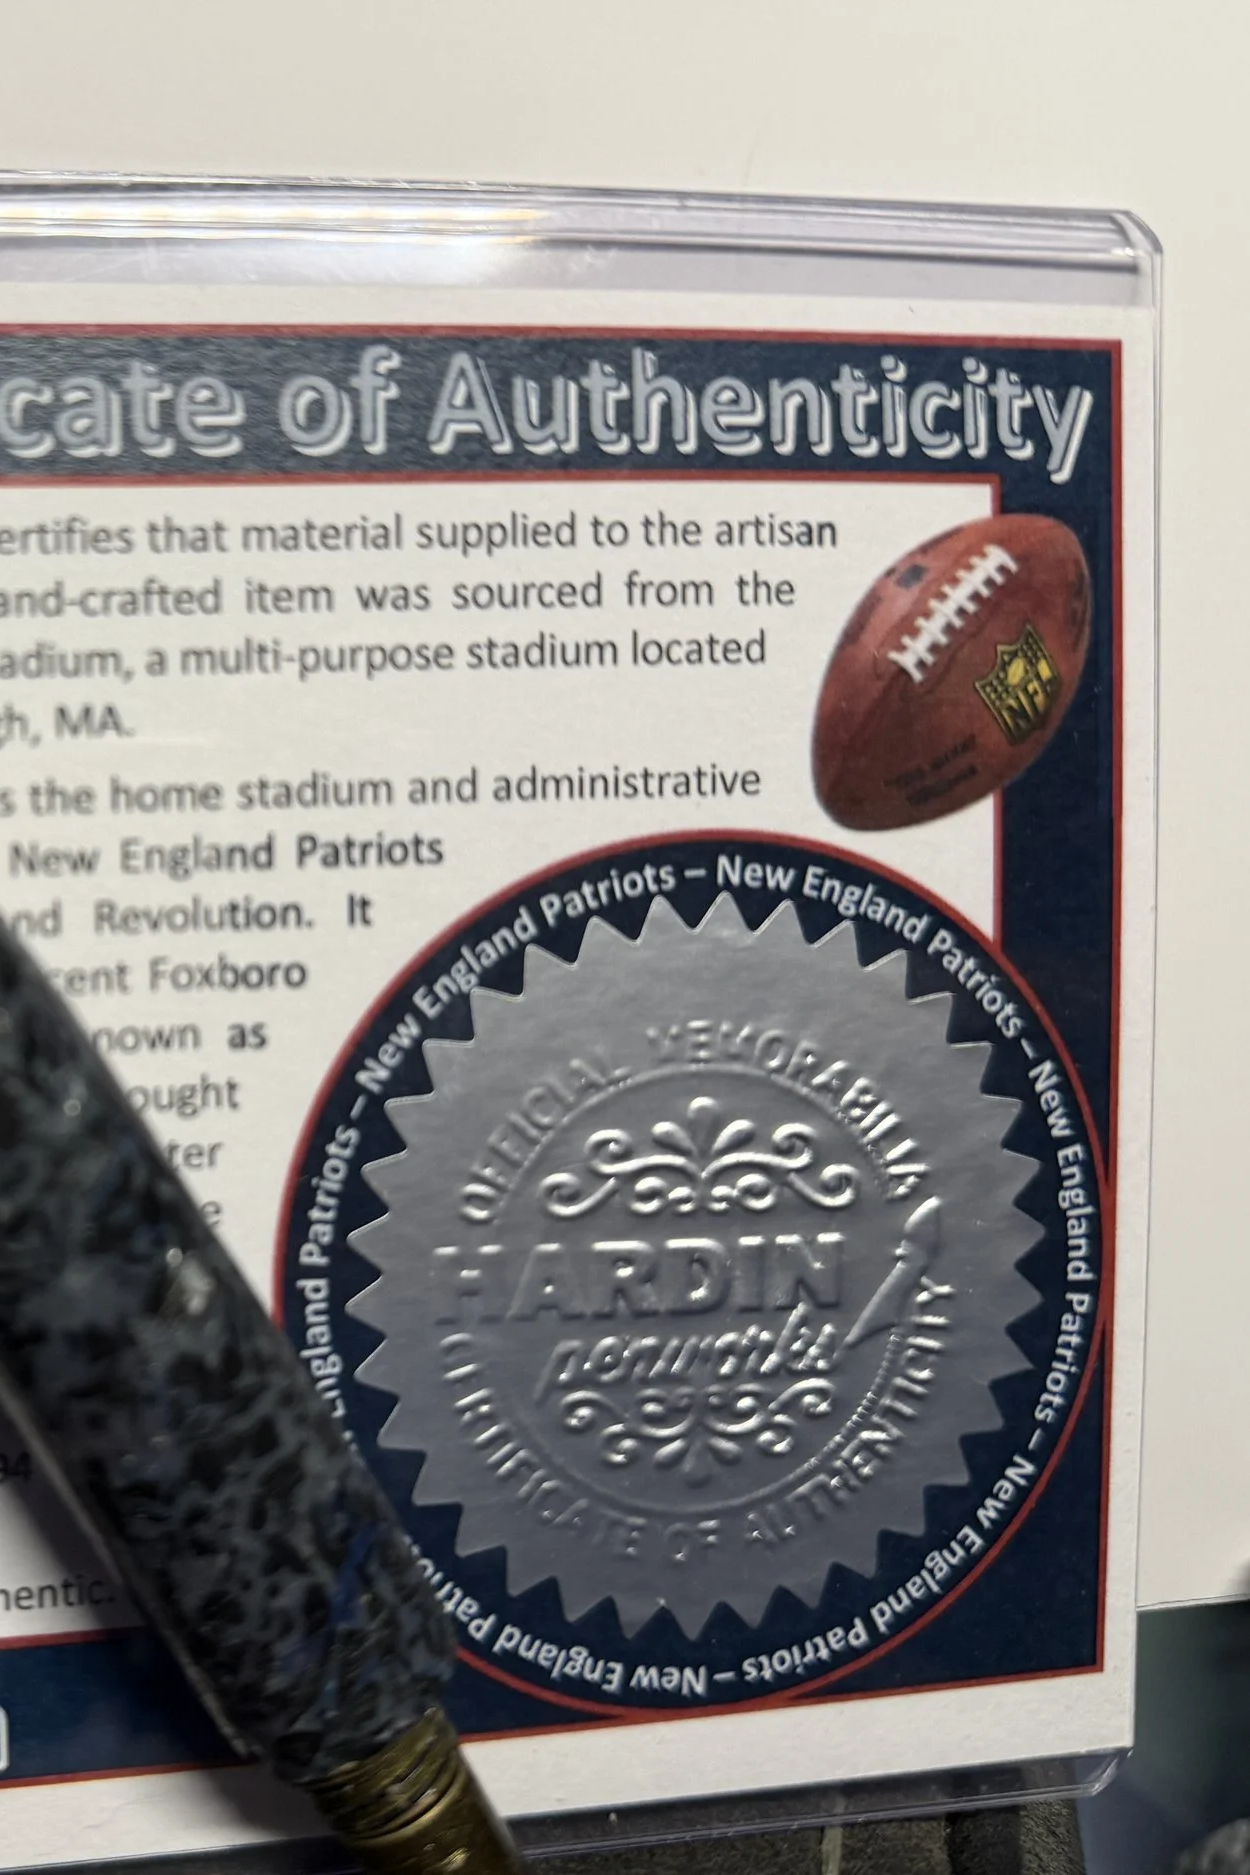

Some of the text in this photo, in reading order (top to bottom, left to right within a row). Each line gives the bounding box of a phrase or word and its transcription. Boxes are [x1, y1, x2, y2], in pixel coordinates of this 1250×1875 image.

[278, 344, 405, 458] of
[426, 349, 1095, 484] Authenticity
[146, 516, 228, 554] that
[242, 512, 403, 552] material
[416, 510, 577, 558] supplied
[590, 515, 630, 548] to
[640, 510, 703, 547] the
[715, 513, 838, 548] artisan
[245, 579, 334, 614] item
[355, 584, 431, 612] was
[452, 570, 603, 610] sourced
[624, 569, 714, 608] from
[735, 570, 796, 607] the
[145, 648, 168, 677] a
[181, 637, 455, 682] multi-purpose
[466, 631, 618, 670] stadium
[632, 628, 766, 667] located
[55, 703, 133, 737] MA.
[29, 779, 96, 816] the
[110, 776, 223, 813] home
[237, 770, 394, 810] stadium
[408, 766, 478, 805] and
[492, 763, 761, 803] administrative
[9, 842, 100, 876] New
[120, 832, 275, 881] England
[296, 831, 445, 869] Patriots
[716, 854, 797, 892] New
[94, 895, 315, 935] Revolution.
[347, 893, 373, 928] It
[538, 863, 677, 928] Patriots
[801, 865, 931, 945] England
[149, 953, 309, 992] Foxboro
[411, 905, 540, 1020] England
[926, 928, 1027, 1039] Patriots
[91, 1022, 202, 1055] nown
[227, 1022, 268, 1051] as
[354, 1012, 422, 1096] New
[125, 1072, 241, 1118] ought
[646, 1019, 931, 1199] MEMORABILIA
[1027, 1060, 1075, 1139] New
[298, 1123, 361, 1267] Patriots
[1056, 1143, 1097, 1283] England
[433, 1233, 846, 1326] HARDIN
[1034, 1291, 1091, 1423] Patriots
[975, 1454, 1038, 1530] New
[869, 1525, 986, 1634] England
[492, 1623, 625, 1694] England
[629, 1664, 709, 1699] New
[741, 1617, 870, 1682] Patriots
